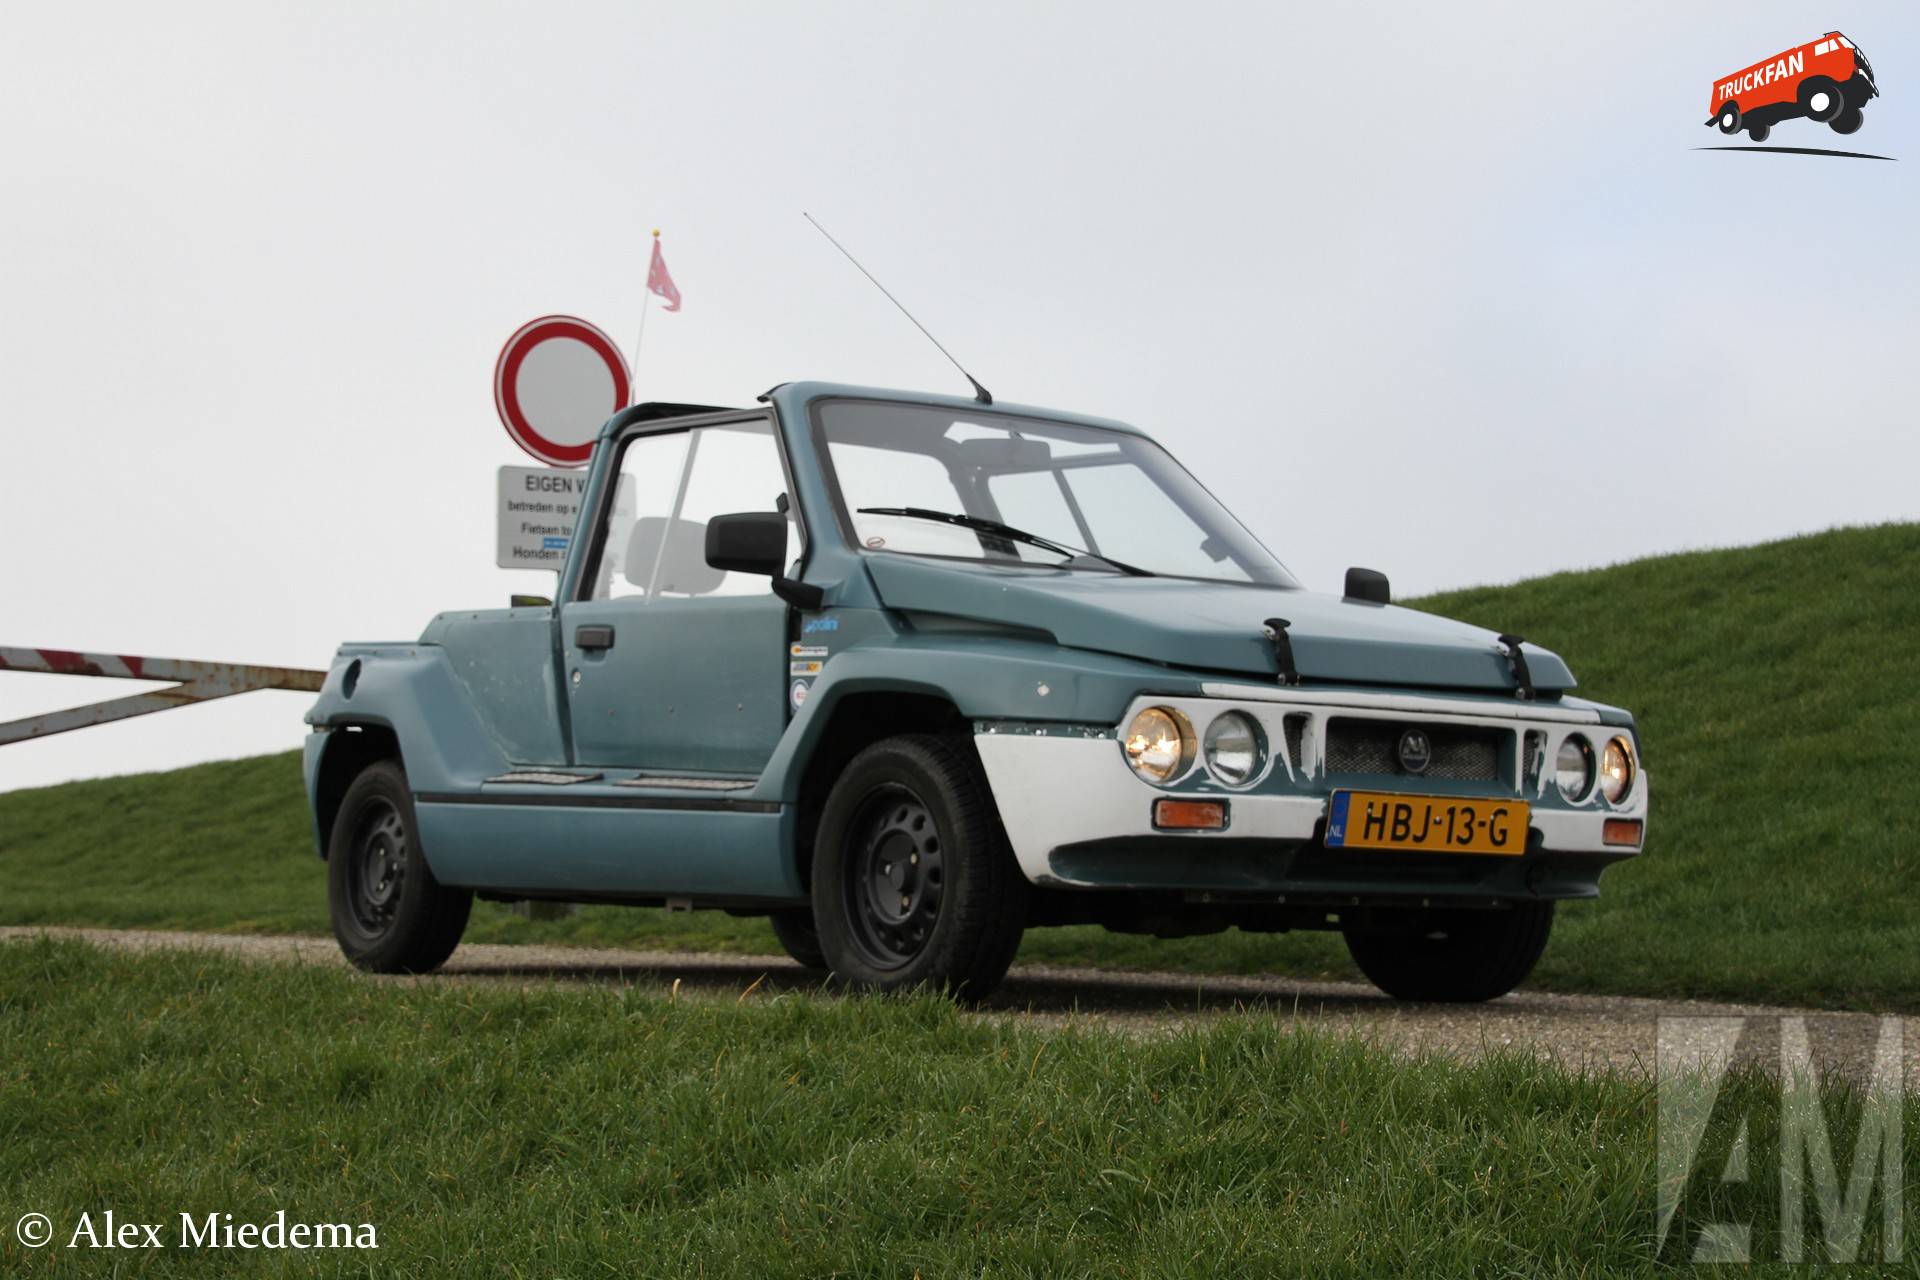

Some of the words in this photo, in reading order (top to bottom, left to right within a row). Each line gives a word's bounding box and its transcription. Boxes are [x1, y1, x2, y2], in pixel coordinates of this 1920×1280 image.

[525, 475, 572, 493] EIGEN
[507, 500, 554, 513] betreden
[556, 504, 569, 515] op
[513, 546, 559, 560] Honden
[1328, 824, 1344, 838] NL
[1363, 801, 1509, 847] HBJ-13-G
